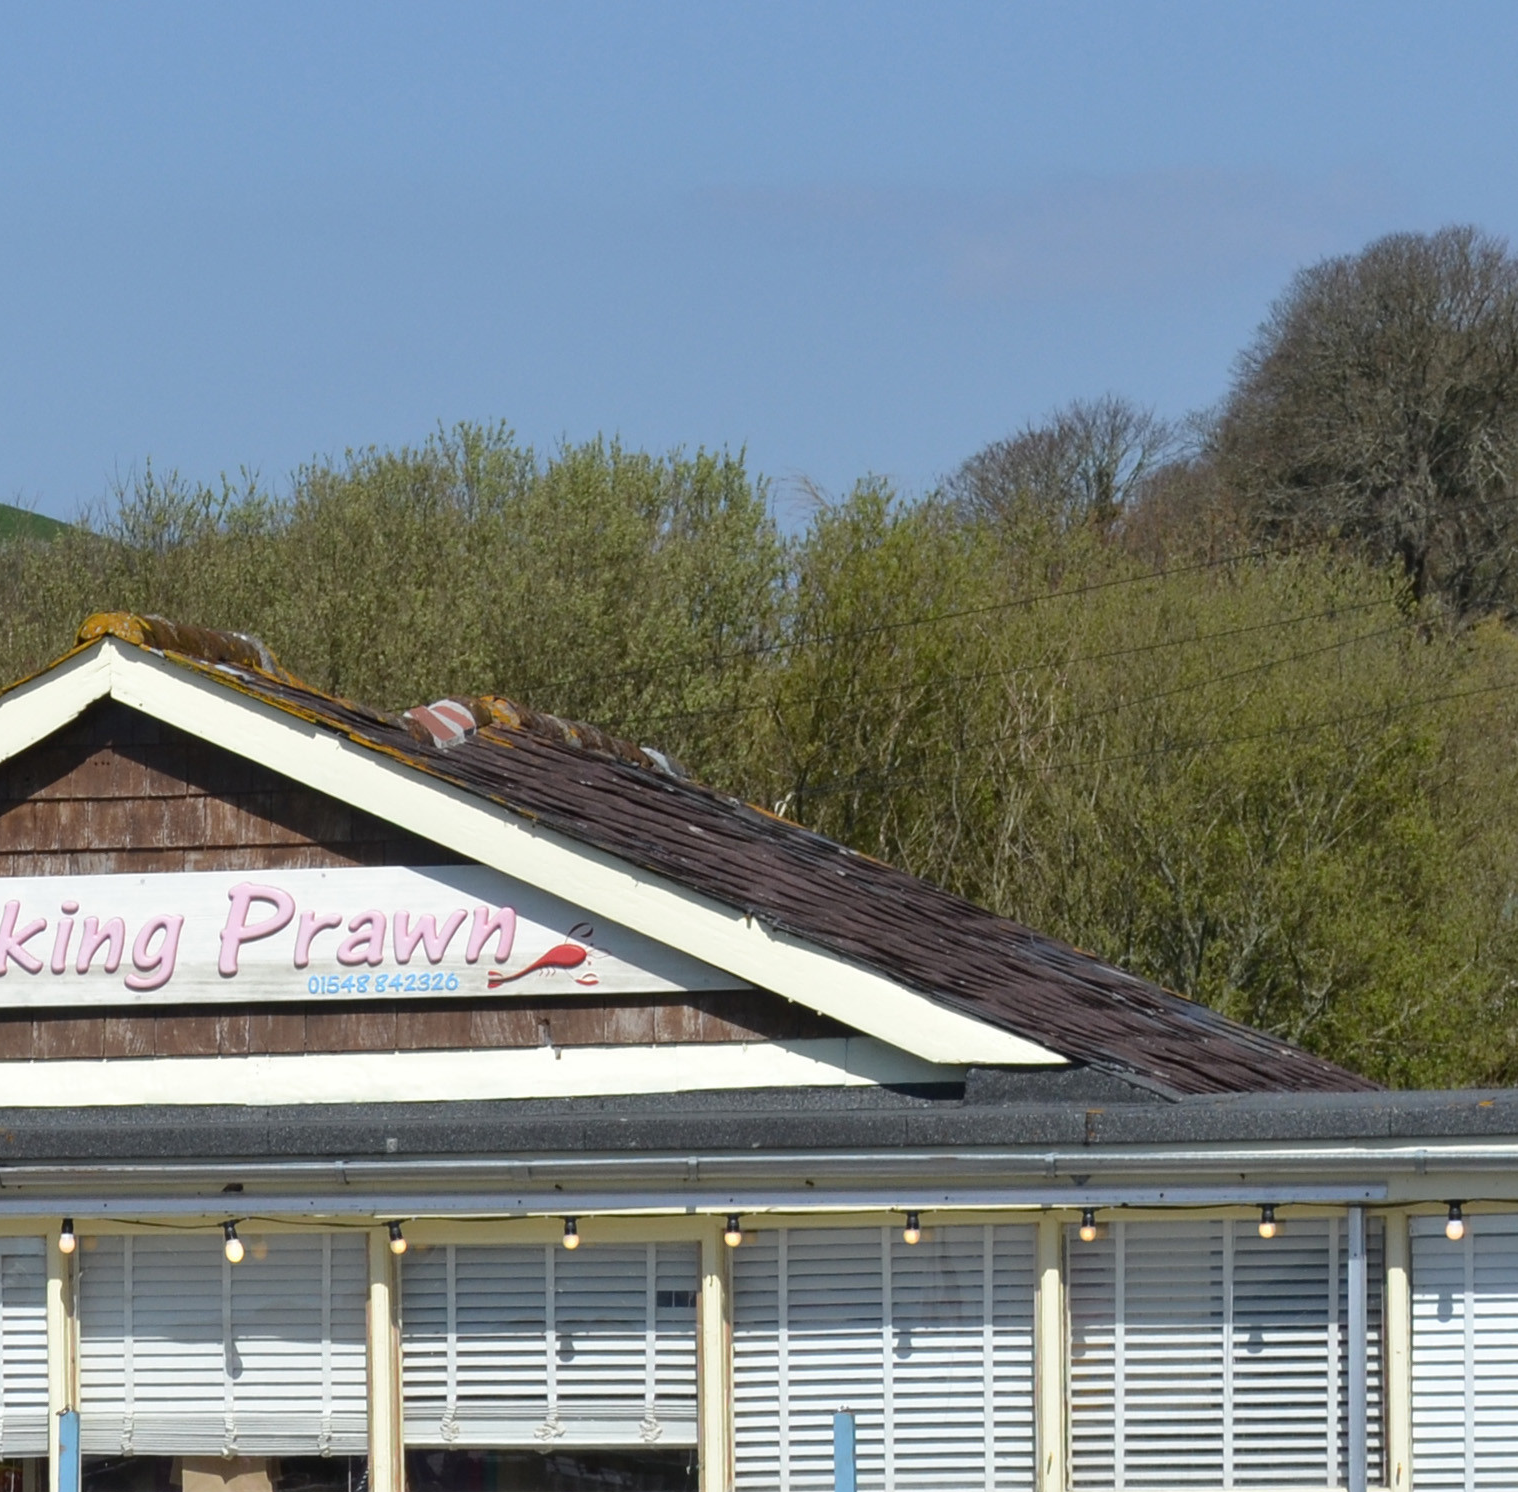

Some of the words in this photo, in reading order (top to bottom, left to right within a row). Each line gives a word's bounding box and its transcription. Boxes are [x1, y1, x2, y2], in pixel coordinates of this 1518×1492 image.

[218, 881, 517, 979] Prawn
[307, 974, 370, 995] 01548
[374, 972, 460, 994] 842326
